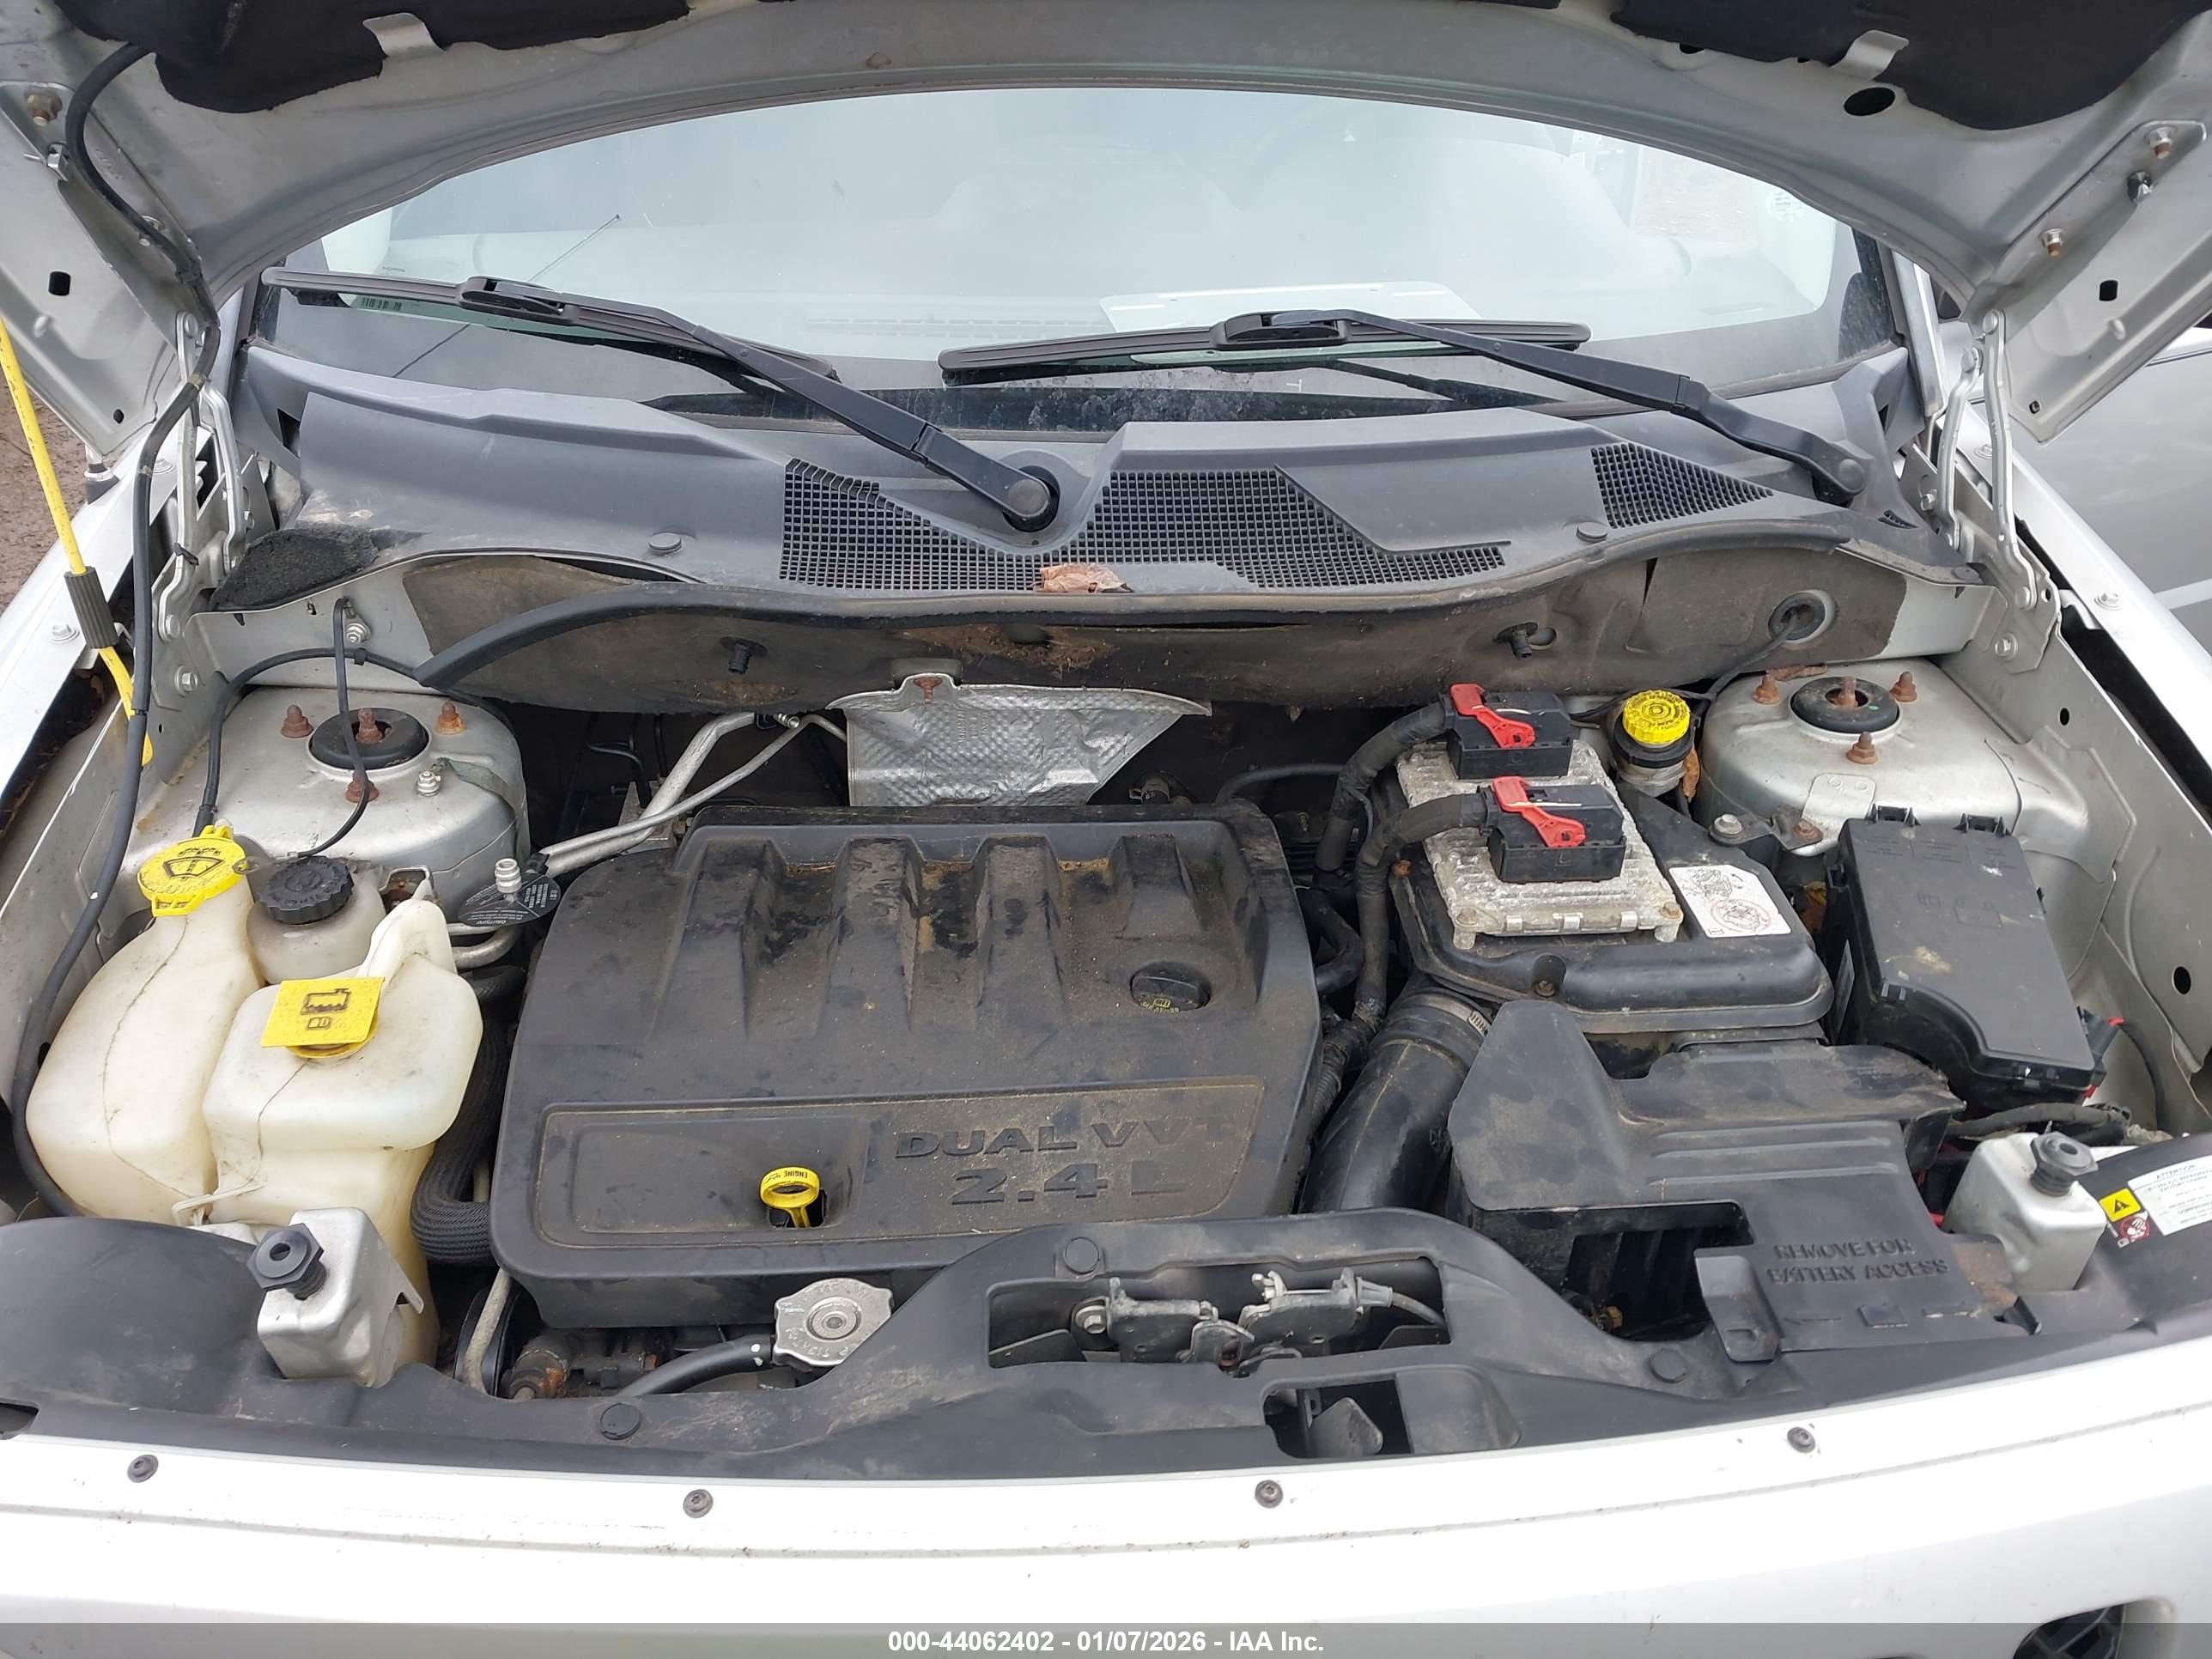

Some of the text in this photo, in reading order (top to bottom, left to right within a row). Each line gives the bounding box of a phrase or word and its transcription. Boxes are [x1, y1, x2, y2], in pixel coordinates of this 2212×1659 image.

[896, 1115, 1229, 1159] DUAL VVT
[1773, 1237, 1916, 1261] REMOVE FOR
[1766, 1259, 1949, 1285] BATTERY ACCESS
